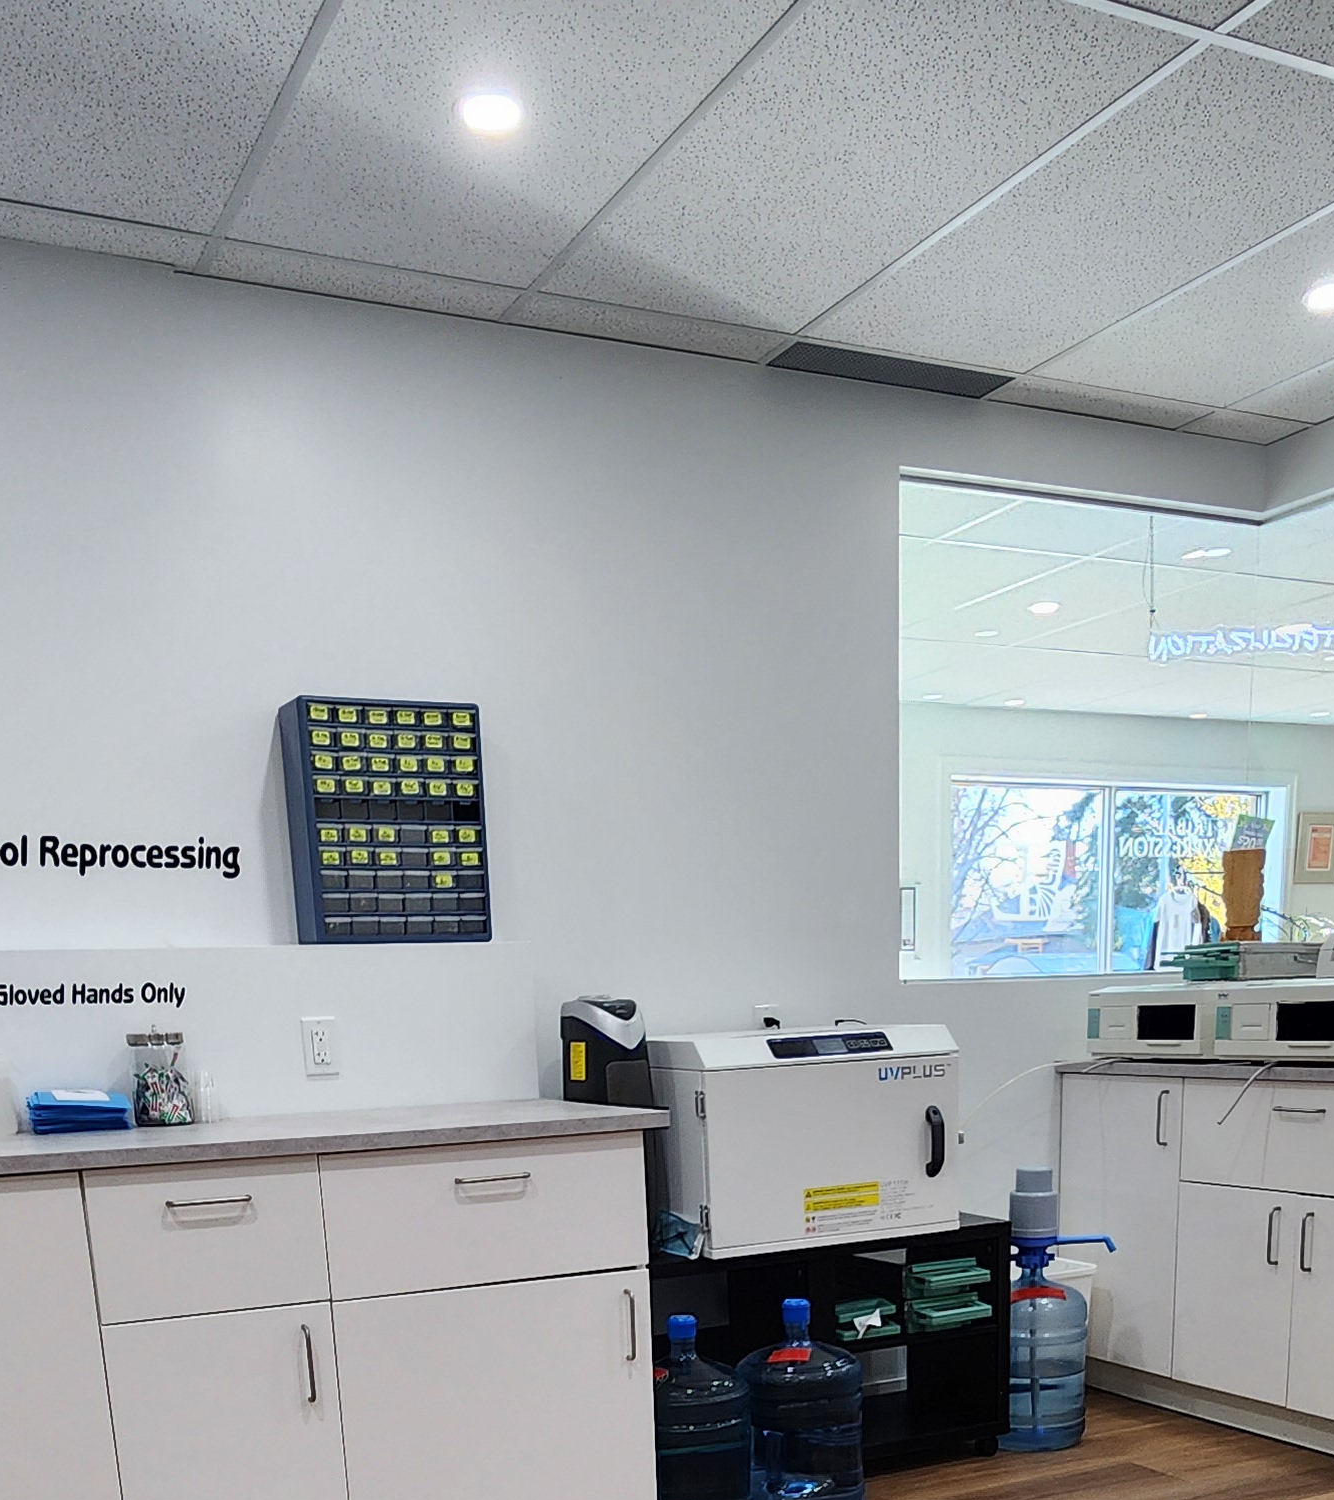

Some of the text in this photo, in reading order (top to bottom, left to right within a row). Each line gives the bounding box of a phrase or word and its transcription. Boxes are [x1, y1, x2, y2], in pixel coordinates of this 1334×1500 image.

[39, 834, 241, 879] Reprocessing
[71, 982, 134, 1005] Hands
[140, 982, 187, 1009] Only
[878, 1065, 946, 1081] UVPLUS
